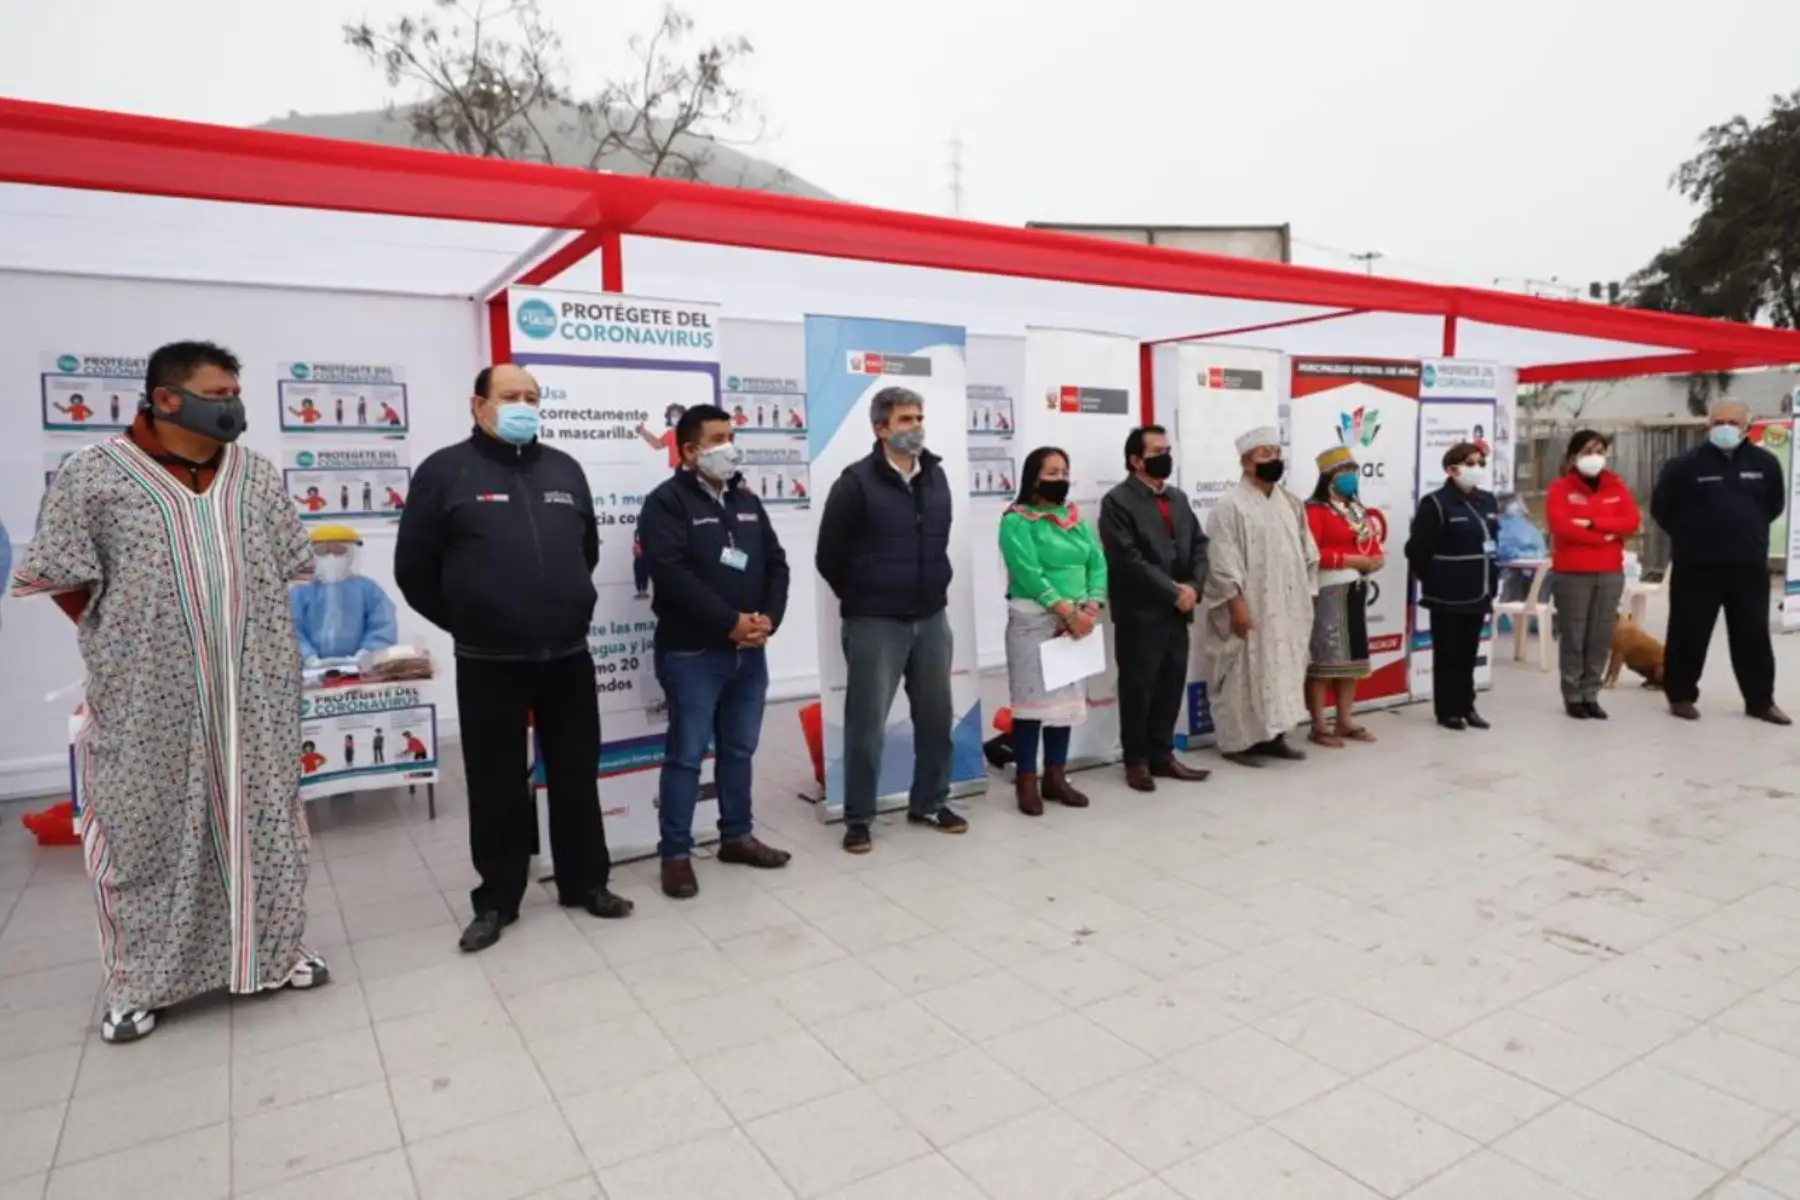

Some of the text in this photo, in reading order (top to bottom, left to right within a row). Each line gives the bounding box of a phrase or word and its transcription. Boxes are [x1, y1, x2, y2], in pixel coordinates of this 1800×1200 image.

[561, 302, 674, 325] PROTÉGETE
[677, 310, 711, 328] DEL
[560, 322, 713, 349] CORONAVIRUS
[539, 385, 567, 400] Usa
[539, 407, 649, 421] correctamente
[540, 425, 638, 439] la mascarilla.
[609, 492, 617, 507] 1
[622, 494, 644, 506] me
[596, 511, 636, 525] cia co
[592, 620, 655, 636] te las ma
[629, 640, 638, 655] y
[641, 637, 655, 654] ja
[596, 656, 639, 674] mo 20
[596, 677, 633, 693] ndos
